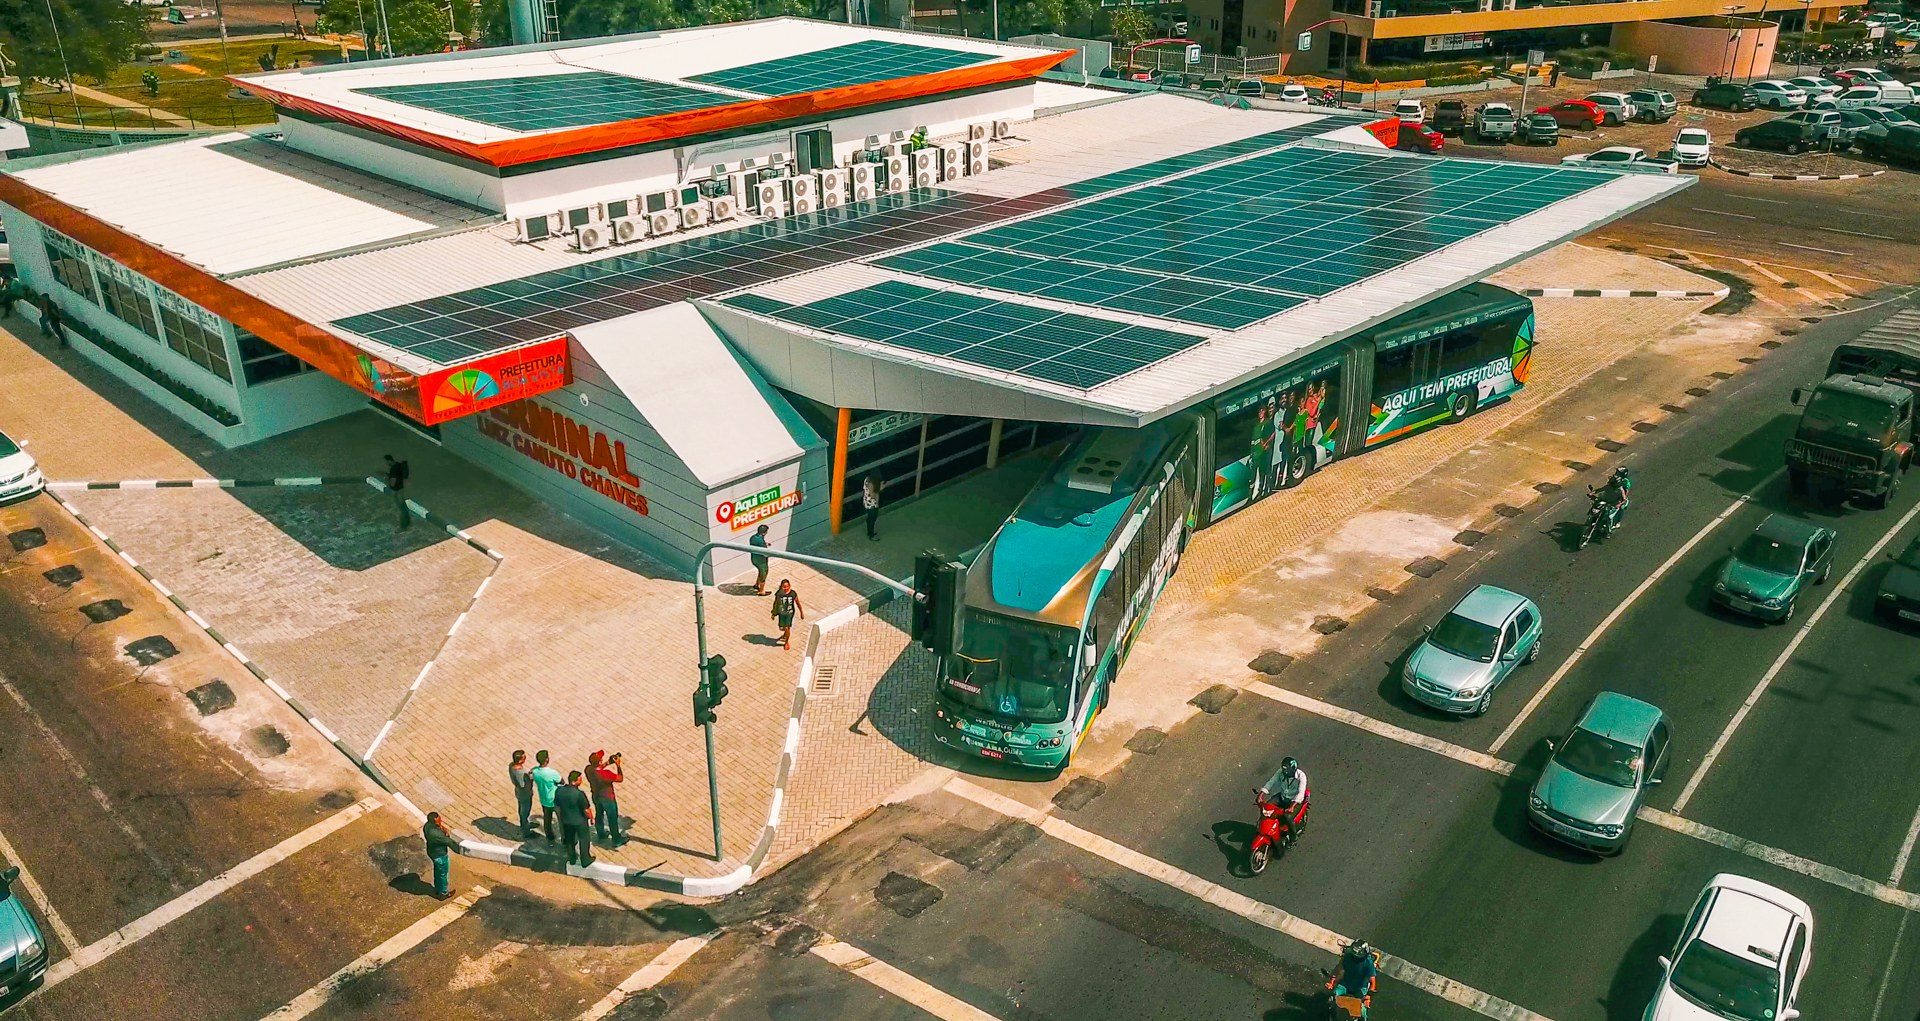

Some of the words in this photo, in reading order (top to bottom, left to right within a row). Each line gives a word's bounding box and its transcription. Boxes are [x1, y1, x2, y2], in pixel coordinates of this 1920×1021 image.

[499, 373, 564, 400] PREFEITURA
[1382, 388, 1416, 413] AQUI
[1419, 382, 1446, 401] TEM
[1446, 357, 1513, 393] PREFEITURA!
[512, 432, 577, 480] CANUTO
[579, 466, 649, 517] CHAVES
[734, 493, 758, 514] Aqui
[759, 489, 778, 504] tem
